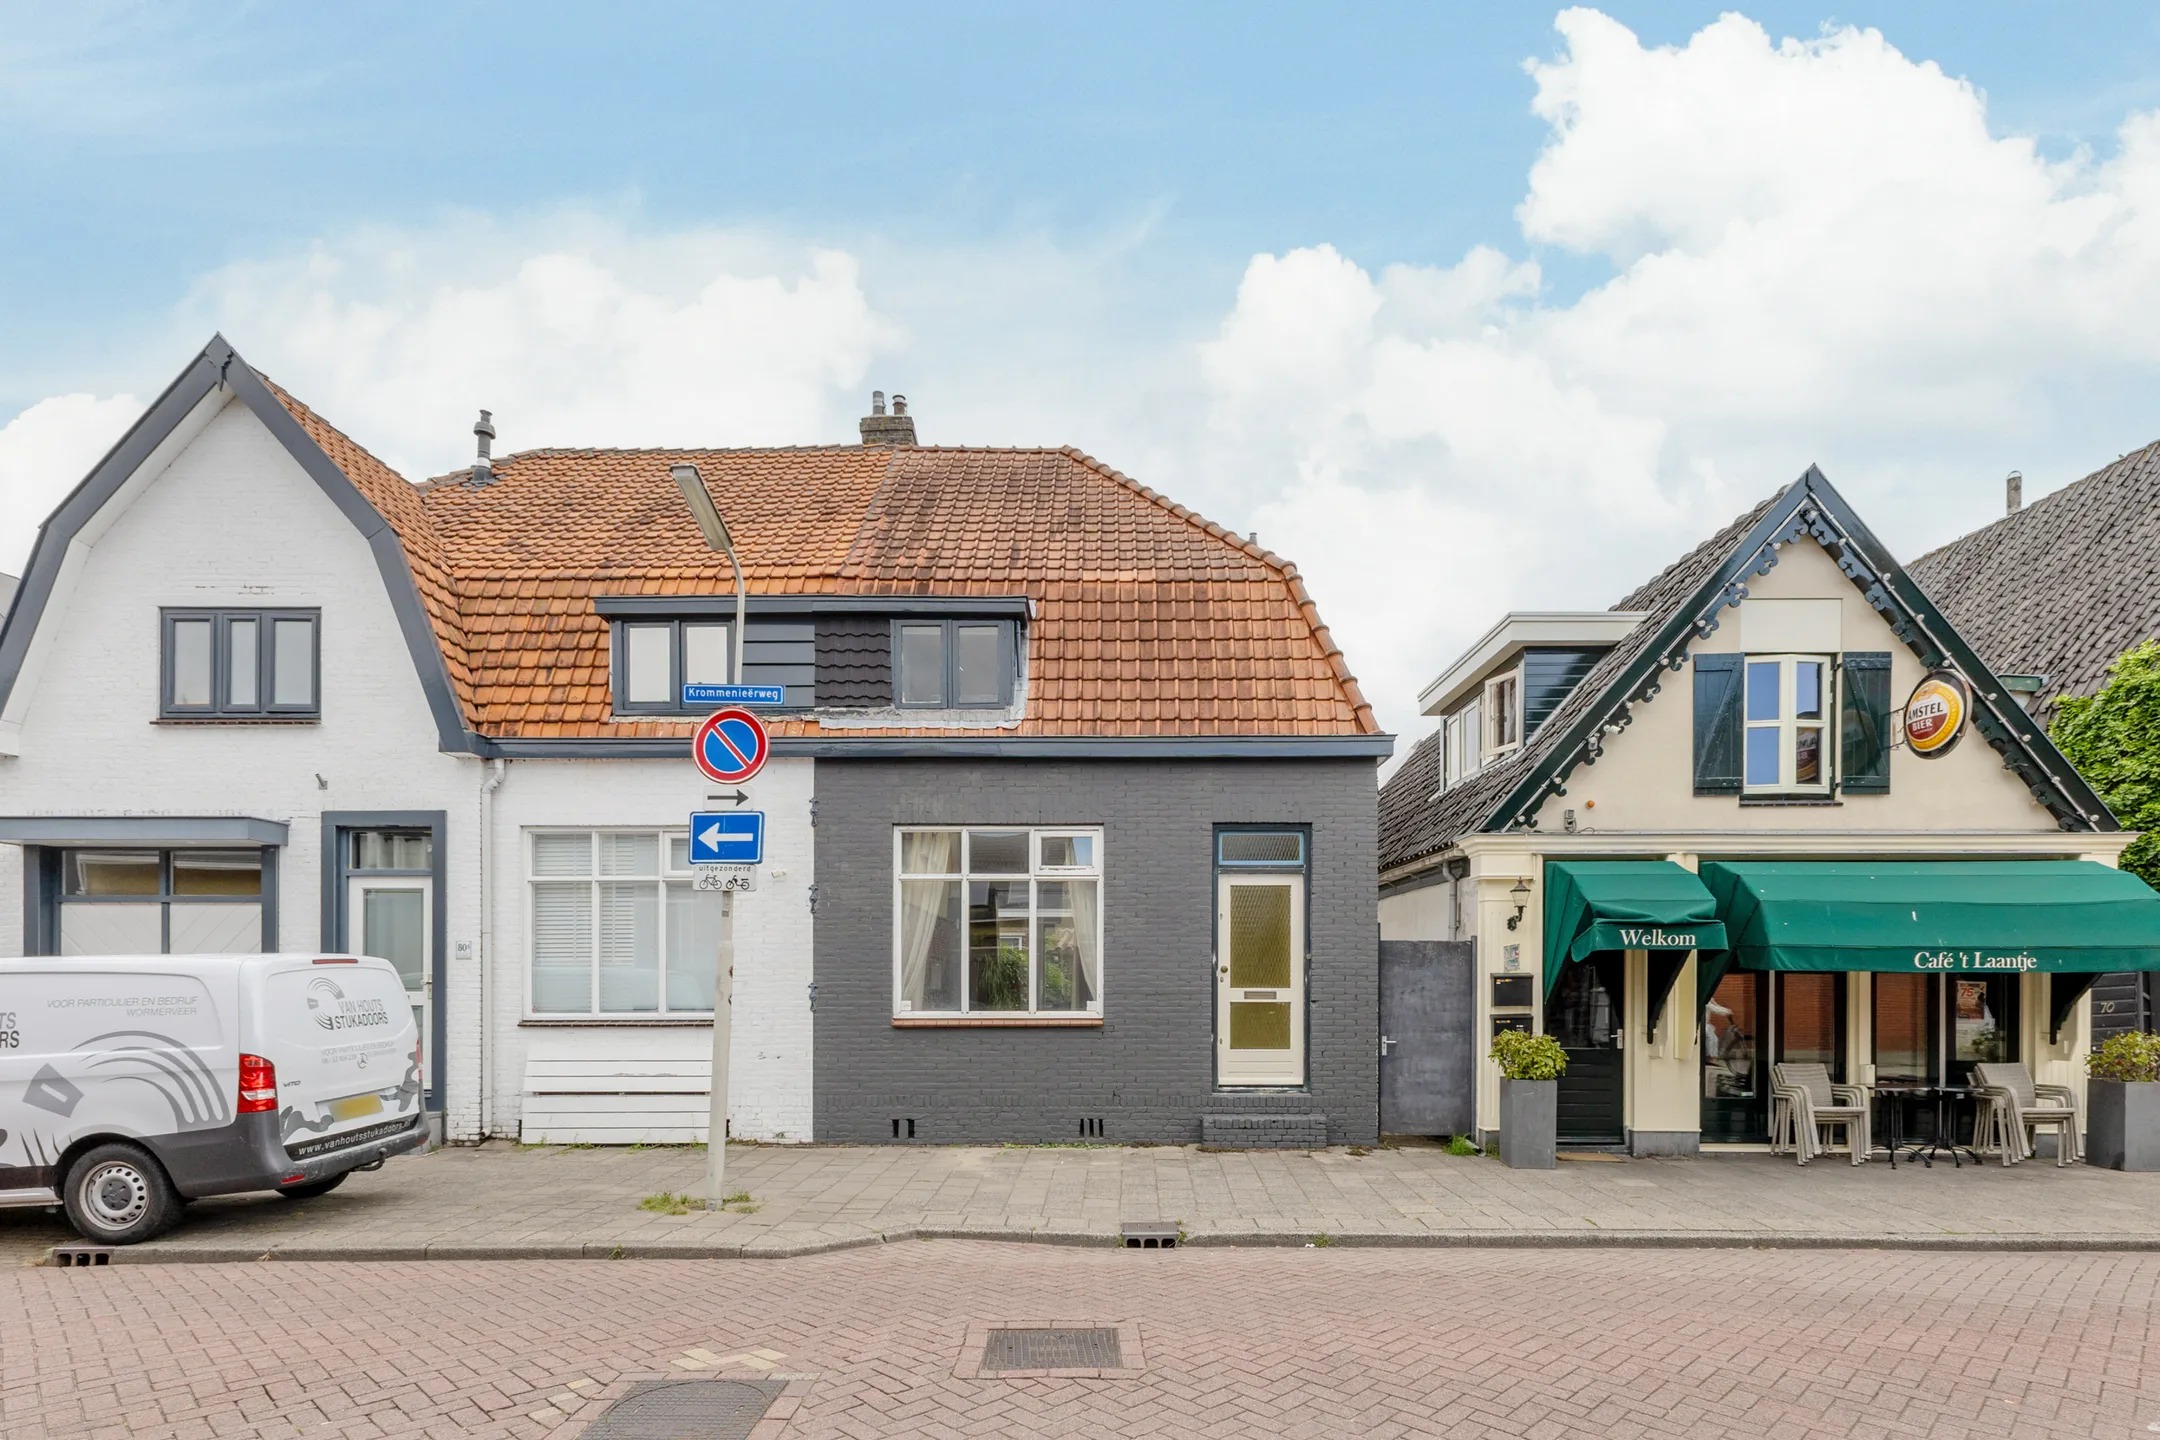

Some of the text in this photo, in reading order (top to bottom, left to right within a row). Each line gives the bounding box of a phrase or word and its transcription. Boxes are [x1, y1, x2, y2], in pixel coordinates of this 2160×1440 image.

[688, 687, 778, 701] Krommenieërweg
[1907, 701, 1944, 721] AMSTEL
[1911, 718, 1933, 732] BIER
[1619, 929, 1696, 945] Welkom
[1913, 951, 2038, 972] Café 't Laantje
[1960, 986, 1974, 997] 75
[47, 995, 199, 1008] VOOR PARTICULIER EN BEDRIJF
[338, 999, 384, 1014] VAN HOUTS
[2100, 1001, 2115, 1013] 70
[126, 1007, 197, 1017] WORMERVEER
[335, 1012, 388, 1029] STUKADOORS
